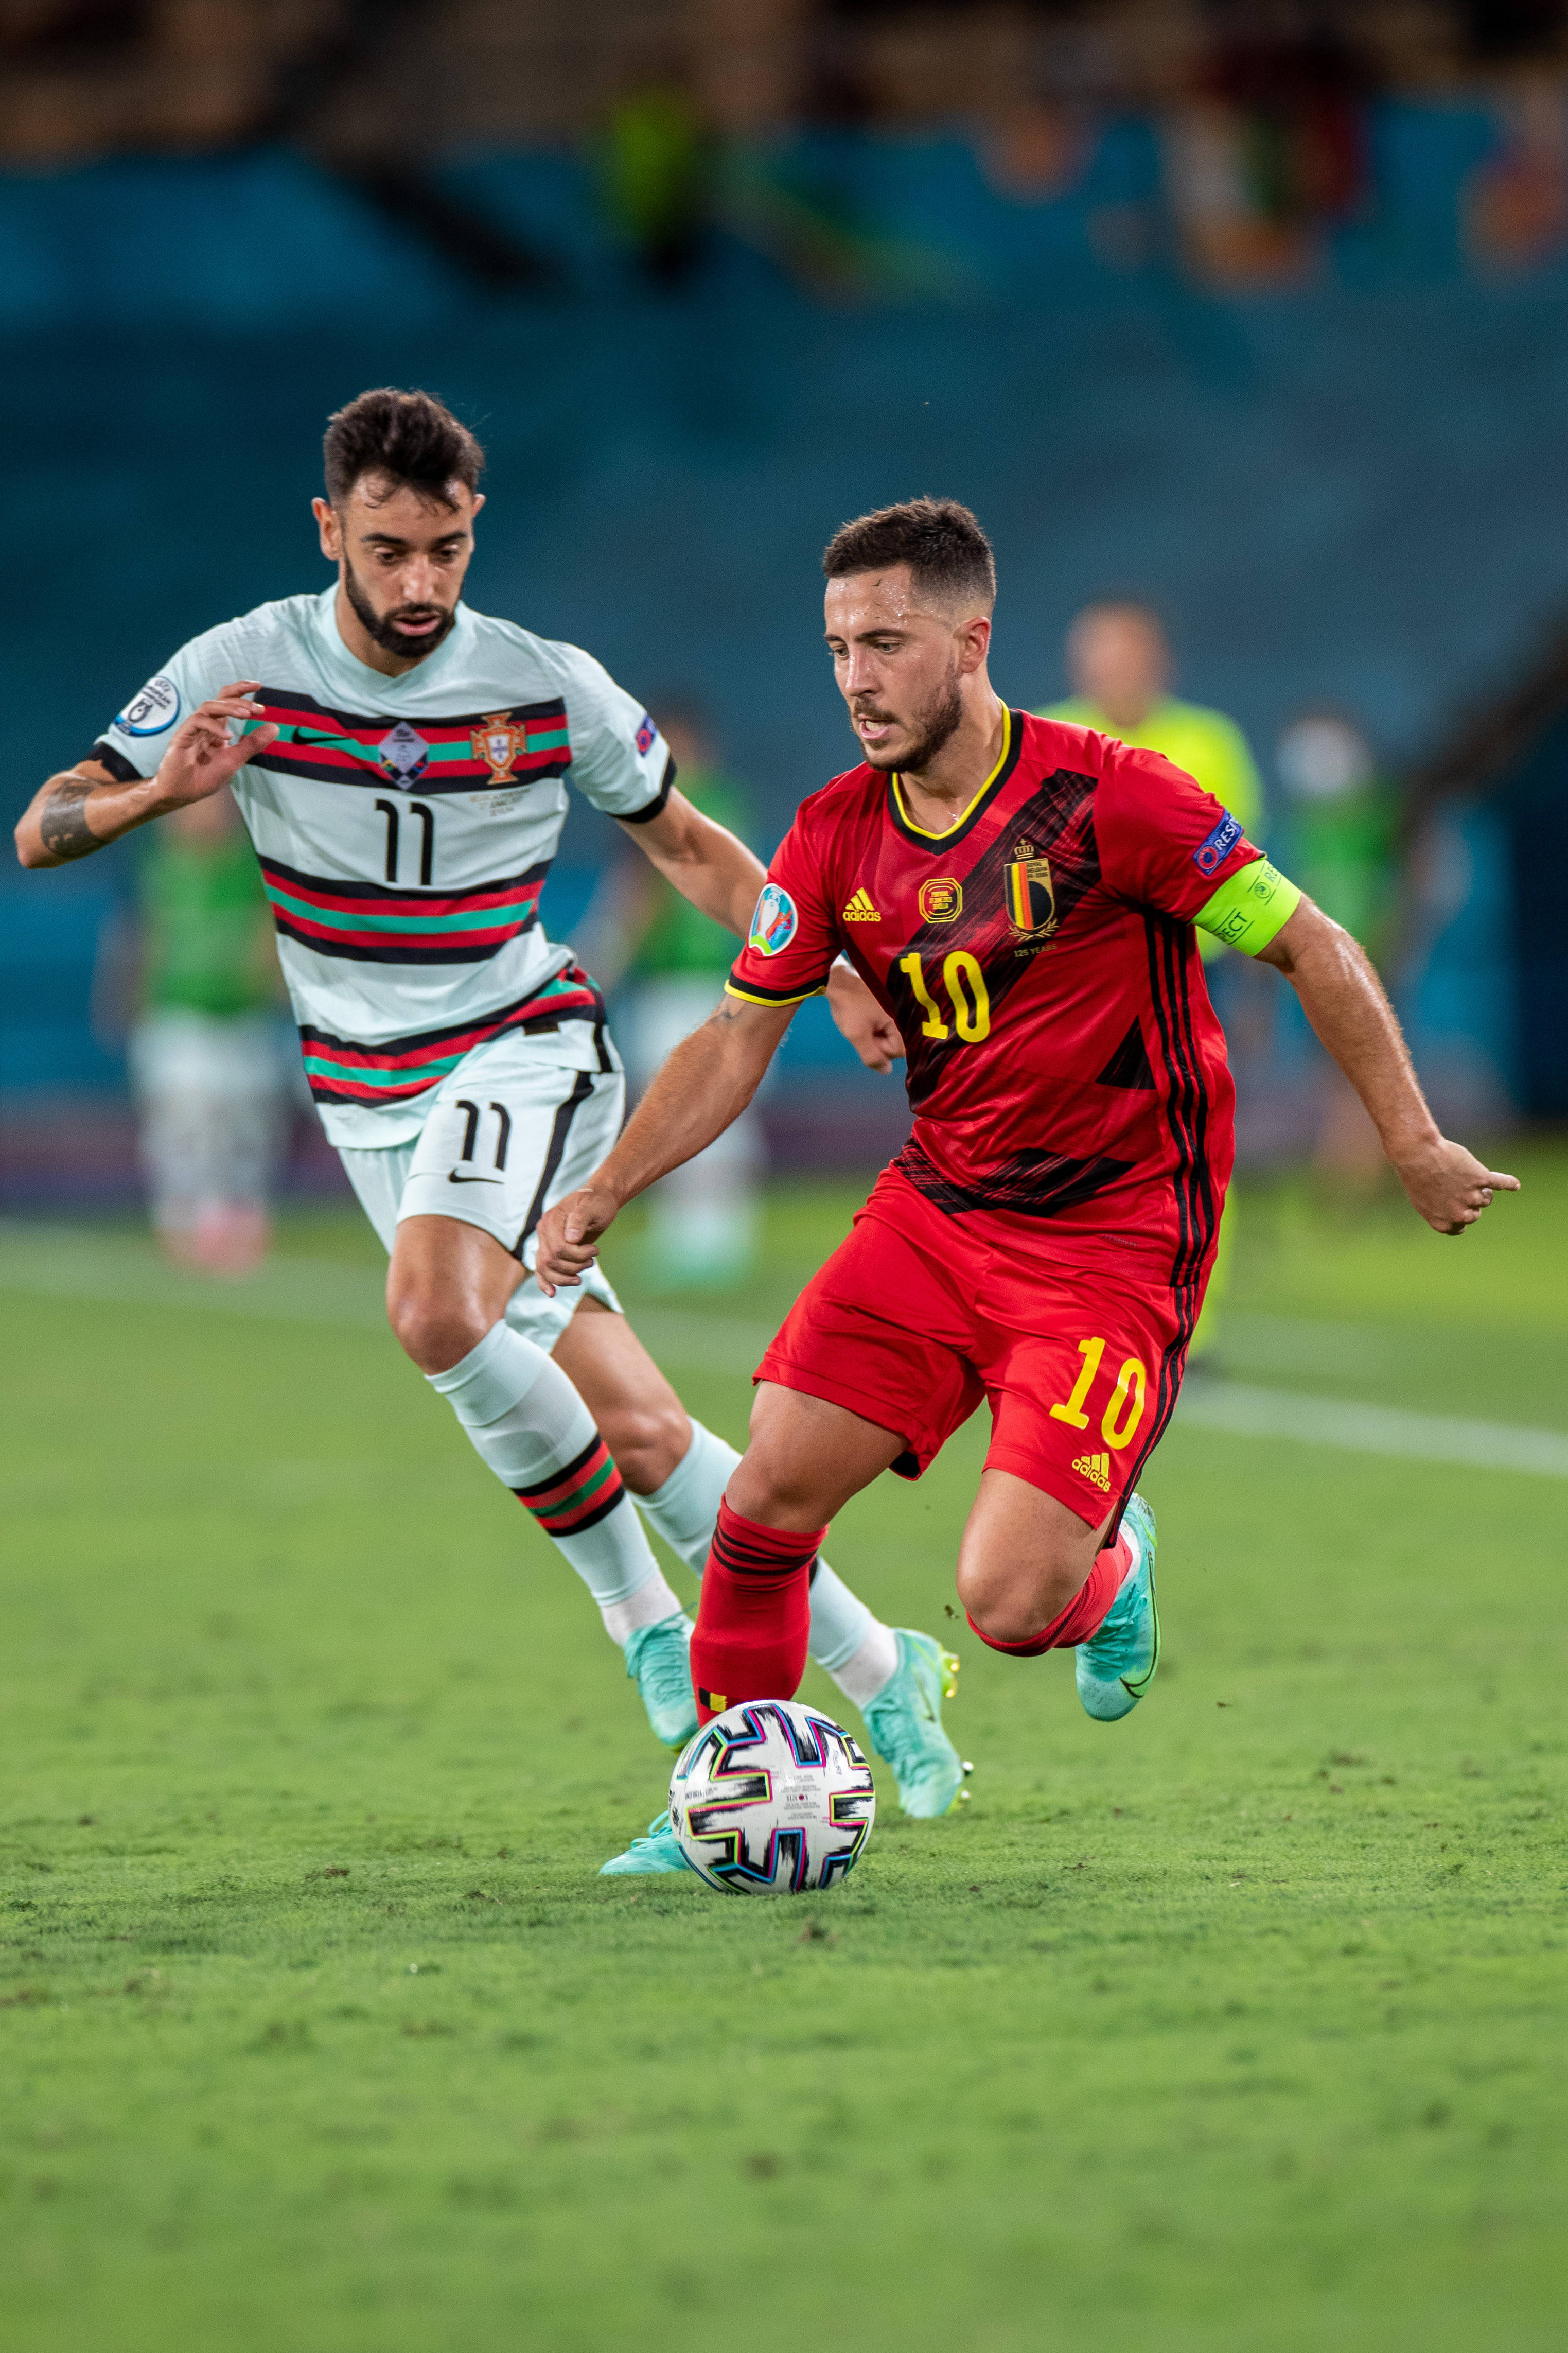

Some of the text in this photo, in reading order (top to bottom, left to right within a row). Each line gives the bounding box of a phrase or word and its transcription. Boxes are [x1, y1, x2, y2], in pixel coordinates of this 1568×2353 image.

[375, 799, 434, 885] 11
[842, 910, 882, 922] adidas
[1014, 944, 1057, 957] 125 YEARS
[899, 950, 991, 1043] 10
[456, 1100, 511, 1172] 11
[1049, 1336, 1146, 1450] 10
[1072, 1458, 1111, 1492] adidas
